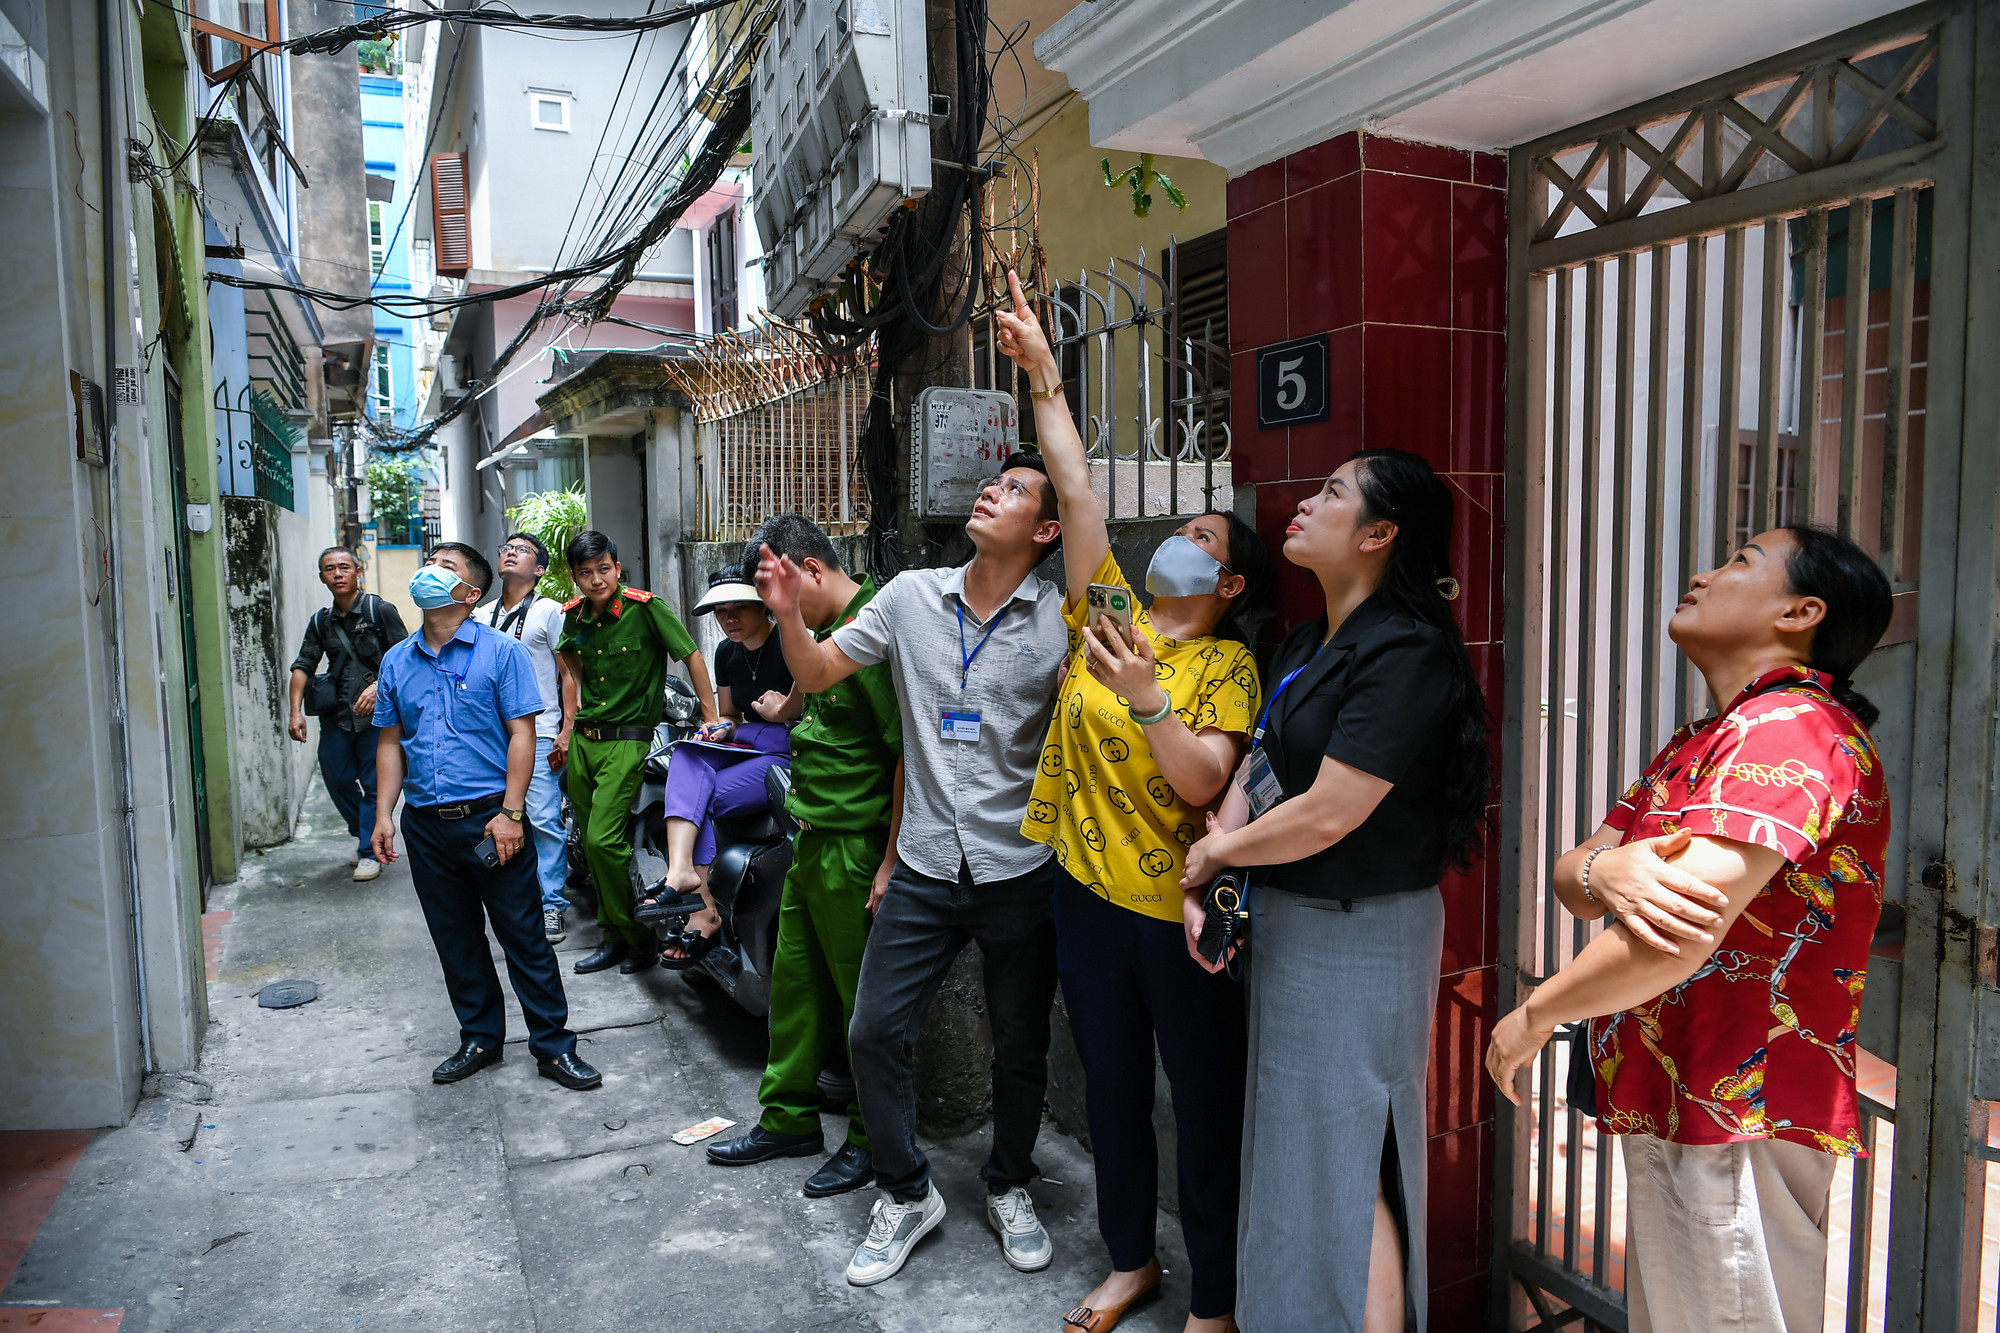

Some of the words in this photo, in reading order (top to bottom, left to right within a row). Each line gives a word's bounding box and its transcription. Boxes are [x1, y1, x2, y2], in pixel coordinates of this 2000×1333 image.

[1277, 356, 1306, 410] 5
[1098, 707, 1126, 729] GUCCI
[1089, 764, 1097, 794] GUCCI
[1120, 827, 1141, 847] GUCCI
[1081, 854, 1103, 875] GUCCI
[1130, 894, 1162, 902] GUCCI
